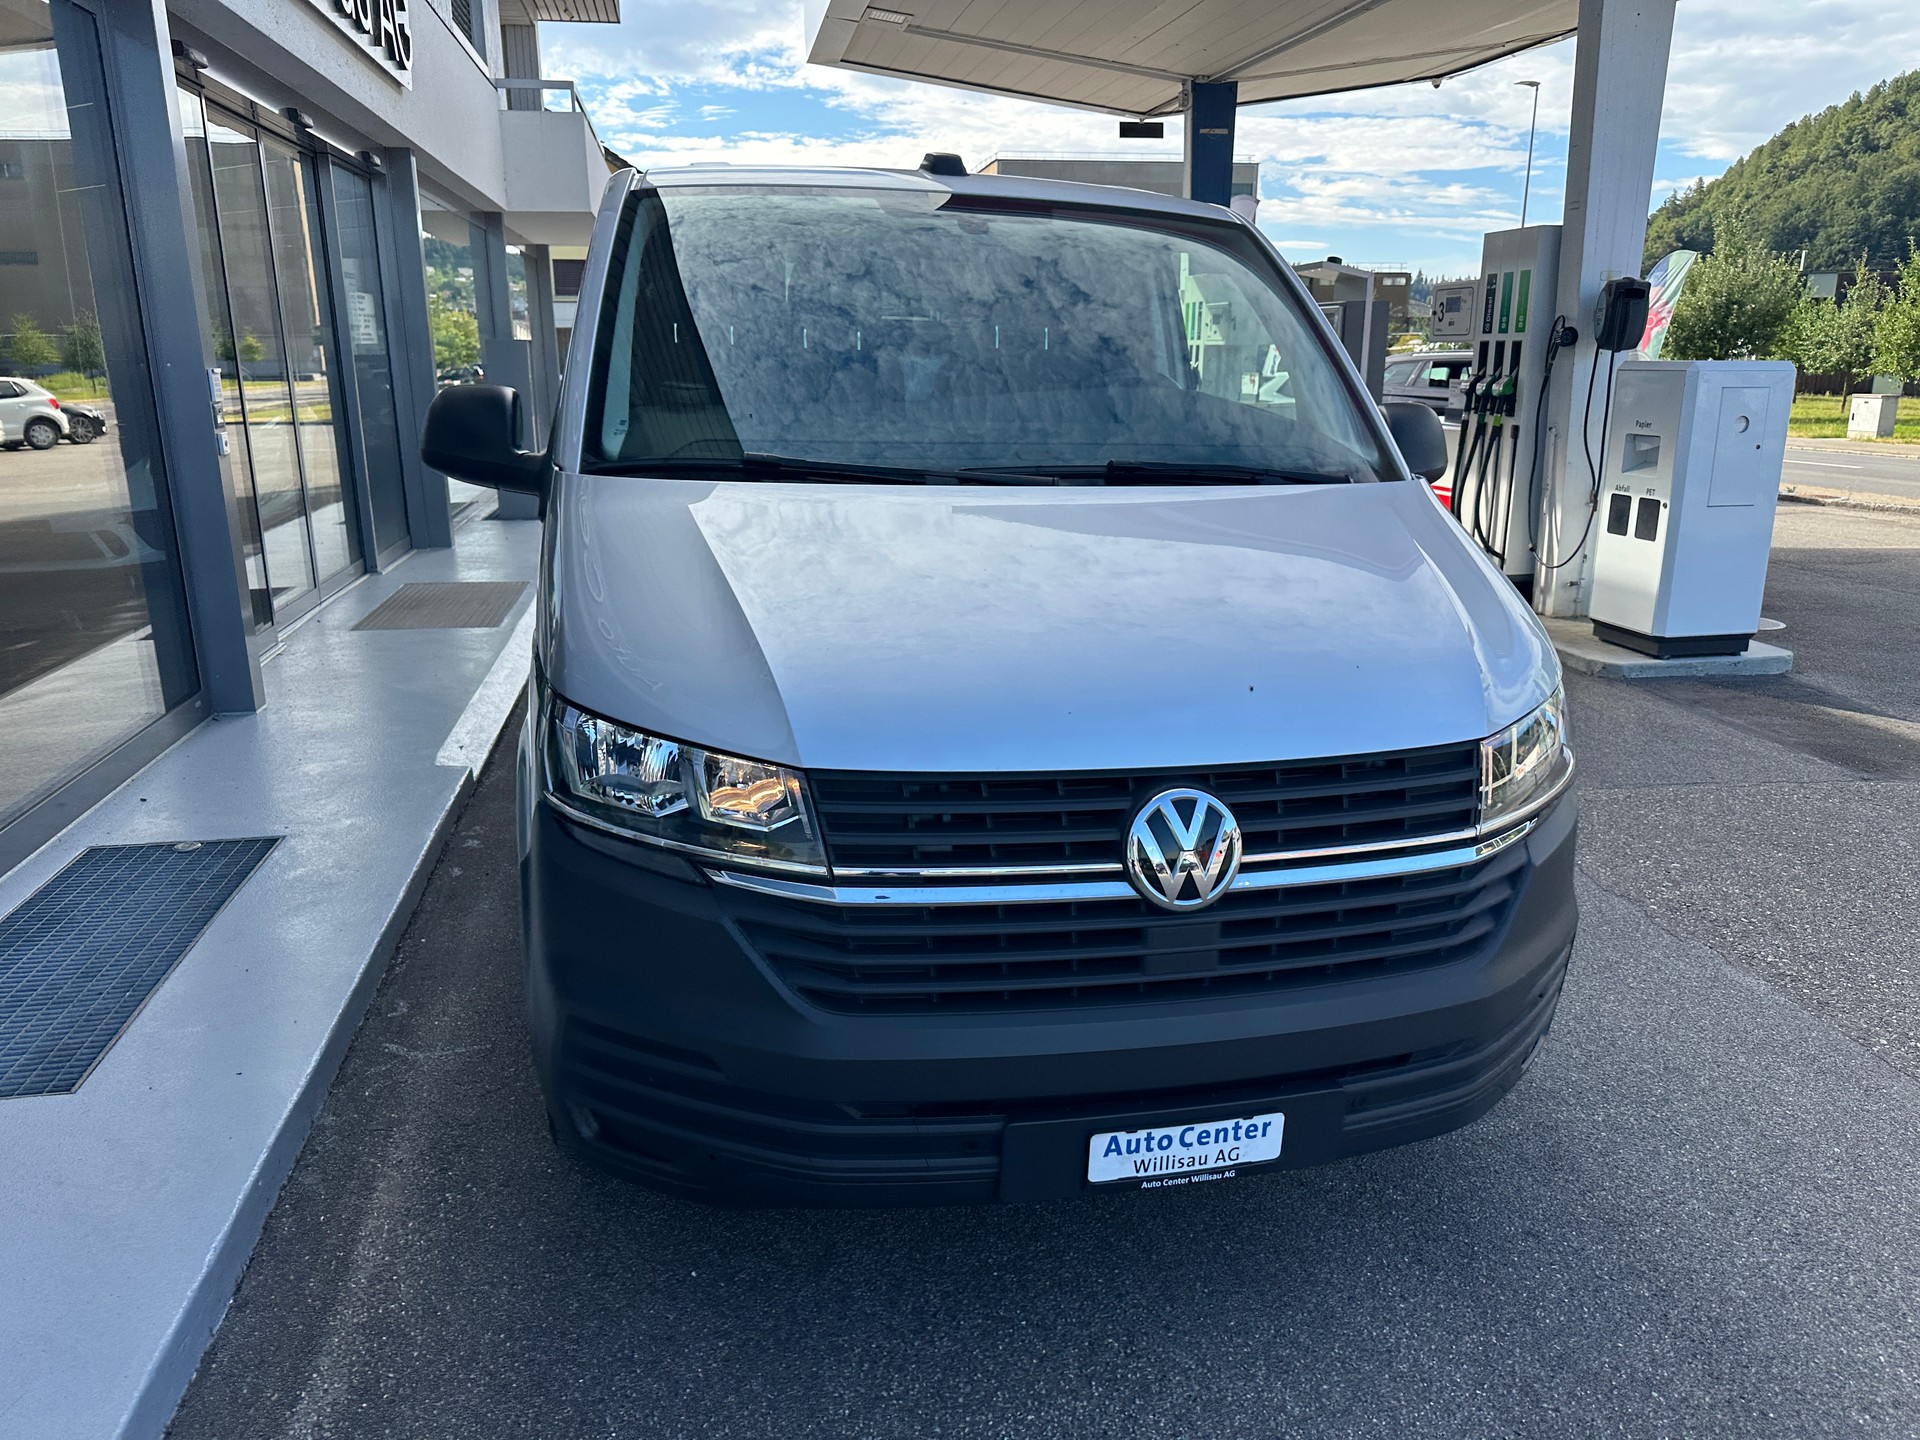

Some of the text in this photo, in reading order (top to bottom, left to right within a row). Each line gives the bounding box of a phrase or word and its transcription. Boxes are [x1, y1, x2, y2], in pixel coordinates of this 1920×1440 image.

[1437, 301, 1445, 323] 3
[1635, 420, 1652, 429] Papier
[1615, 484, 1631, 493] Abfall
[1645, 488, 1656, 496] PET
[1103, 1120, 1272, 1157] Auto Center
[1133, 1147, 1240, 1174] Willisau AG
[1141, 1170, 1236, 1189] Auto Center Willisau AG
